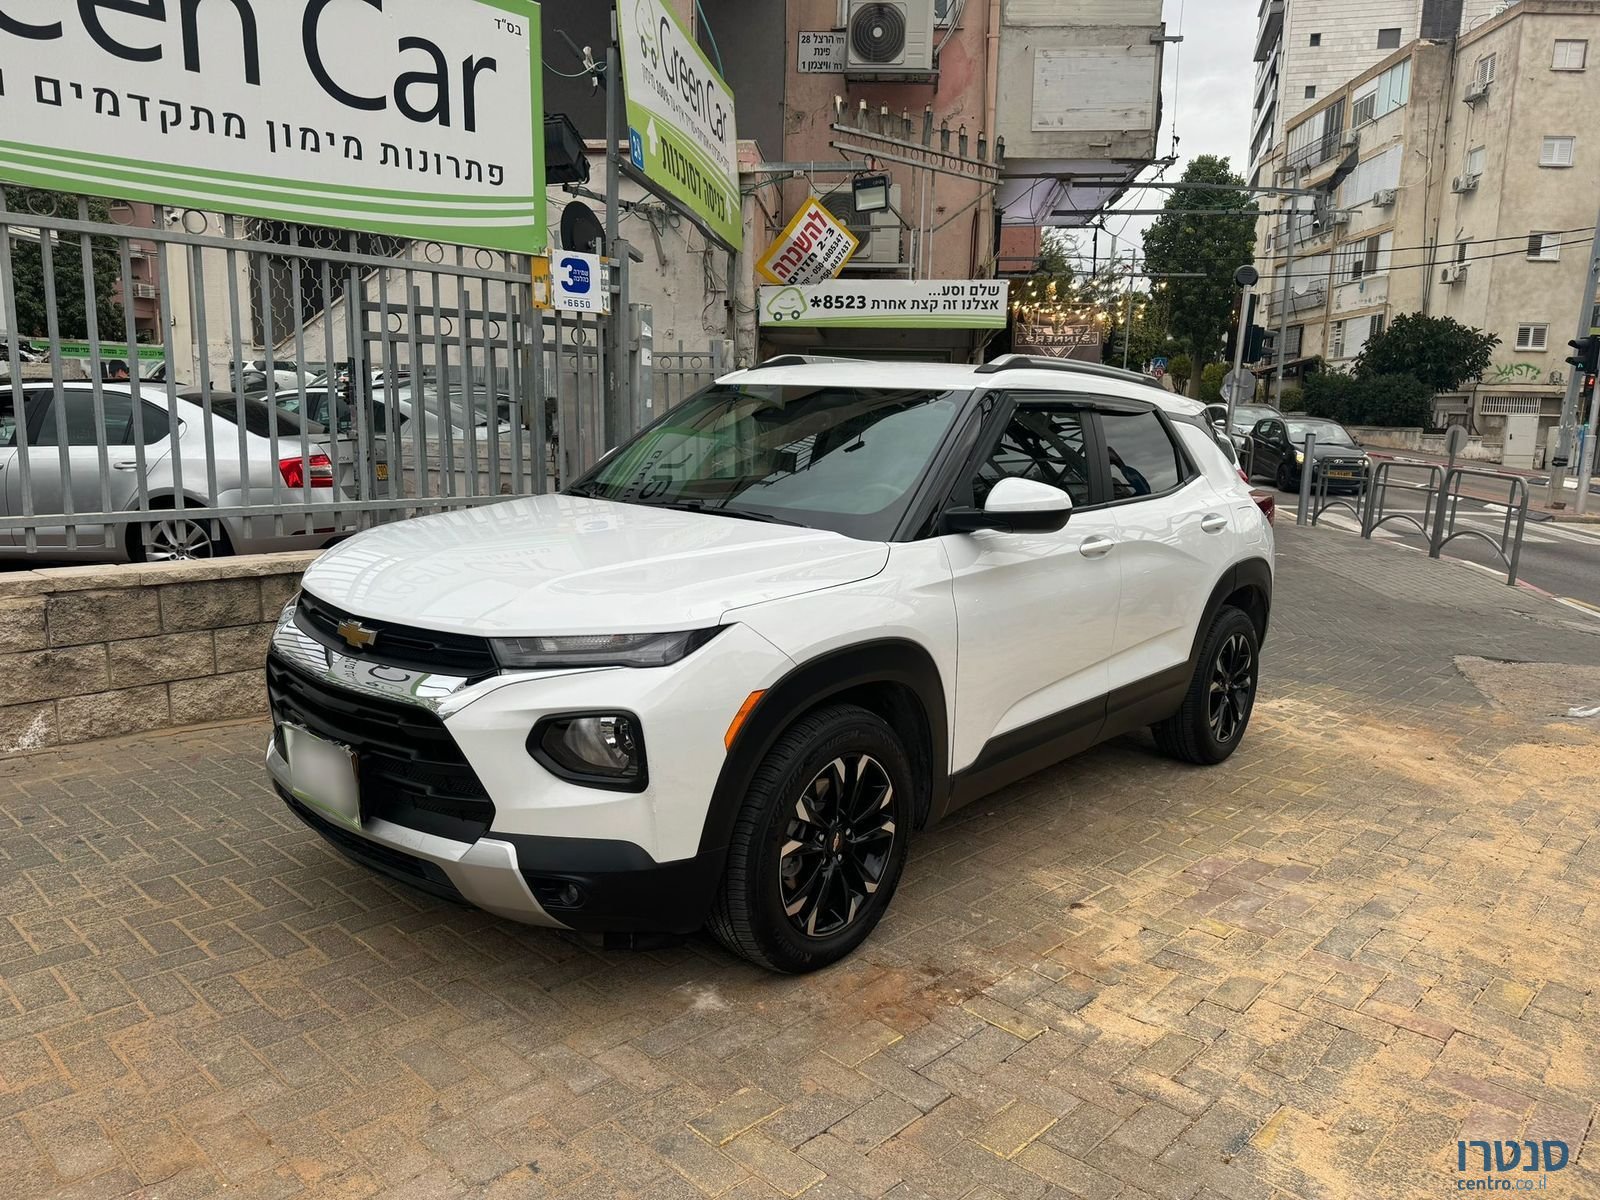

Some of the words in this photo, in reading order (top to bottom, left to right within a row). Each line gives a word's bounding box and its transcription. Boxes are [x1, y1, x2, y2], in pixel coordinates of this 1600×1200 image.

[801, 35, 811, 44] 28
[813, 33, 834, 44] הרצל
[813, 47, 831, 56] פינת
[302, 0, 497, 132] Car
[801, 61, 806, 70] 1
[660, 16, 706, 123] Green
[706, 79, 727, 148] Car
[34, 75, 246, 140] מתקדמים
[266, 120, 363, 160] מימון
[380, 142, 504, 186] פתרונות
[703, 176, 725, 222] כניסה
[771, 210, 828, 279] להשכרה
[787, 252, 818, 285] חדרים
[928, 286, 965, 296] וסע...
[969, 284, 1000, 297] שלם
[870, 299, 906, 310] אחרת
[910, 299, 938, 312] קצת
[943, 299, 958, 310] זה
[961, 297, 999, 310] אצלנו
